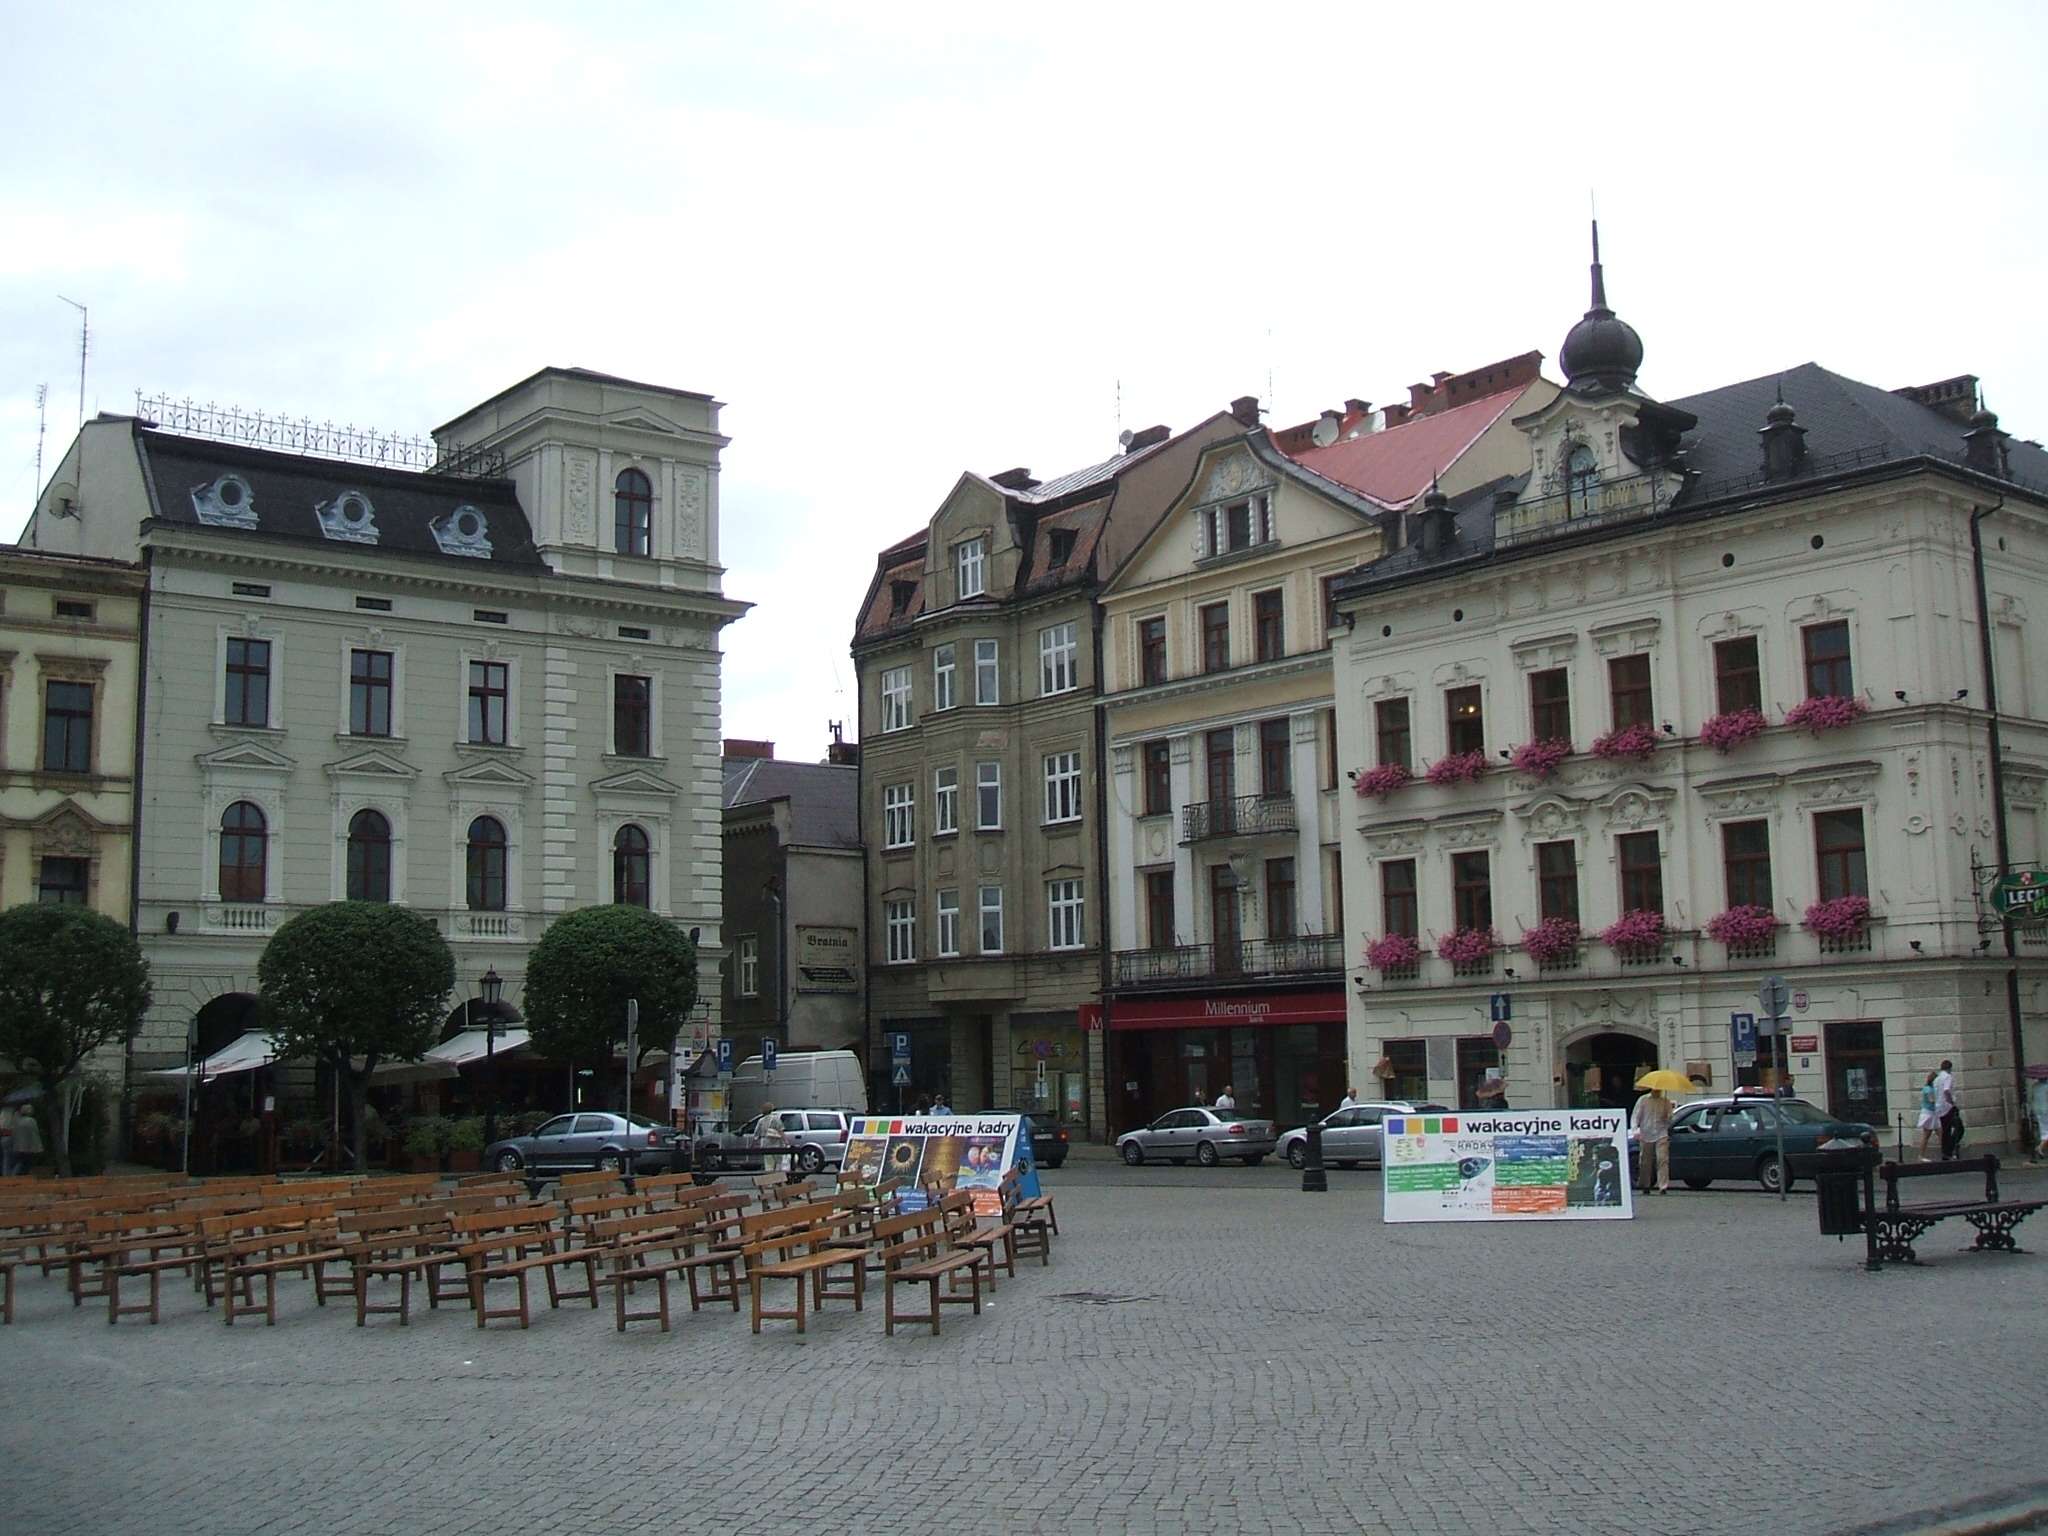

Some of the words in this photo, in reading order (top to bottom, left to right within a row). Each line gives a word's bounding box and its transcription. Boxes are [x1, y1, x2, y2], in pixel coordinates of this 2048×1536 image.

[1205, 1000, 1270, 1016] Millennium
[1090, 1014, 1103, 1030] M
[1736, 1017, 1750, 1041] P
[765, 1041, 774, 1060] P
[896, 1035, 907, 1051] P
[720, 1042, 730, 1062] P
[905, 1121, 973, 1136] wakacyjne
[977, 1120, 1015, 1136] kadry
[1466, 1117, 1562, 1135] wakacyjne
[1570, 1115, 1621, 1132] kadry
